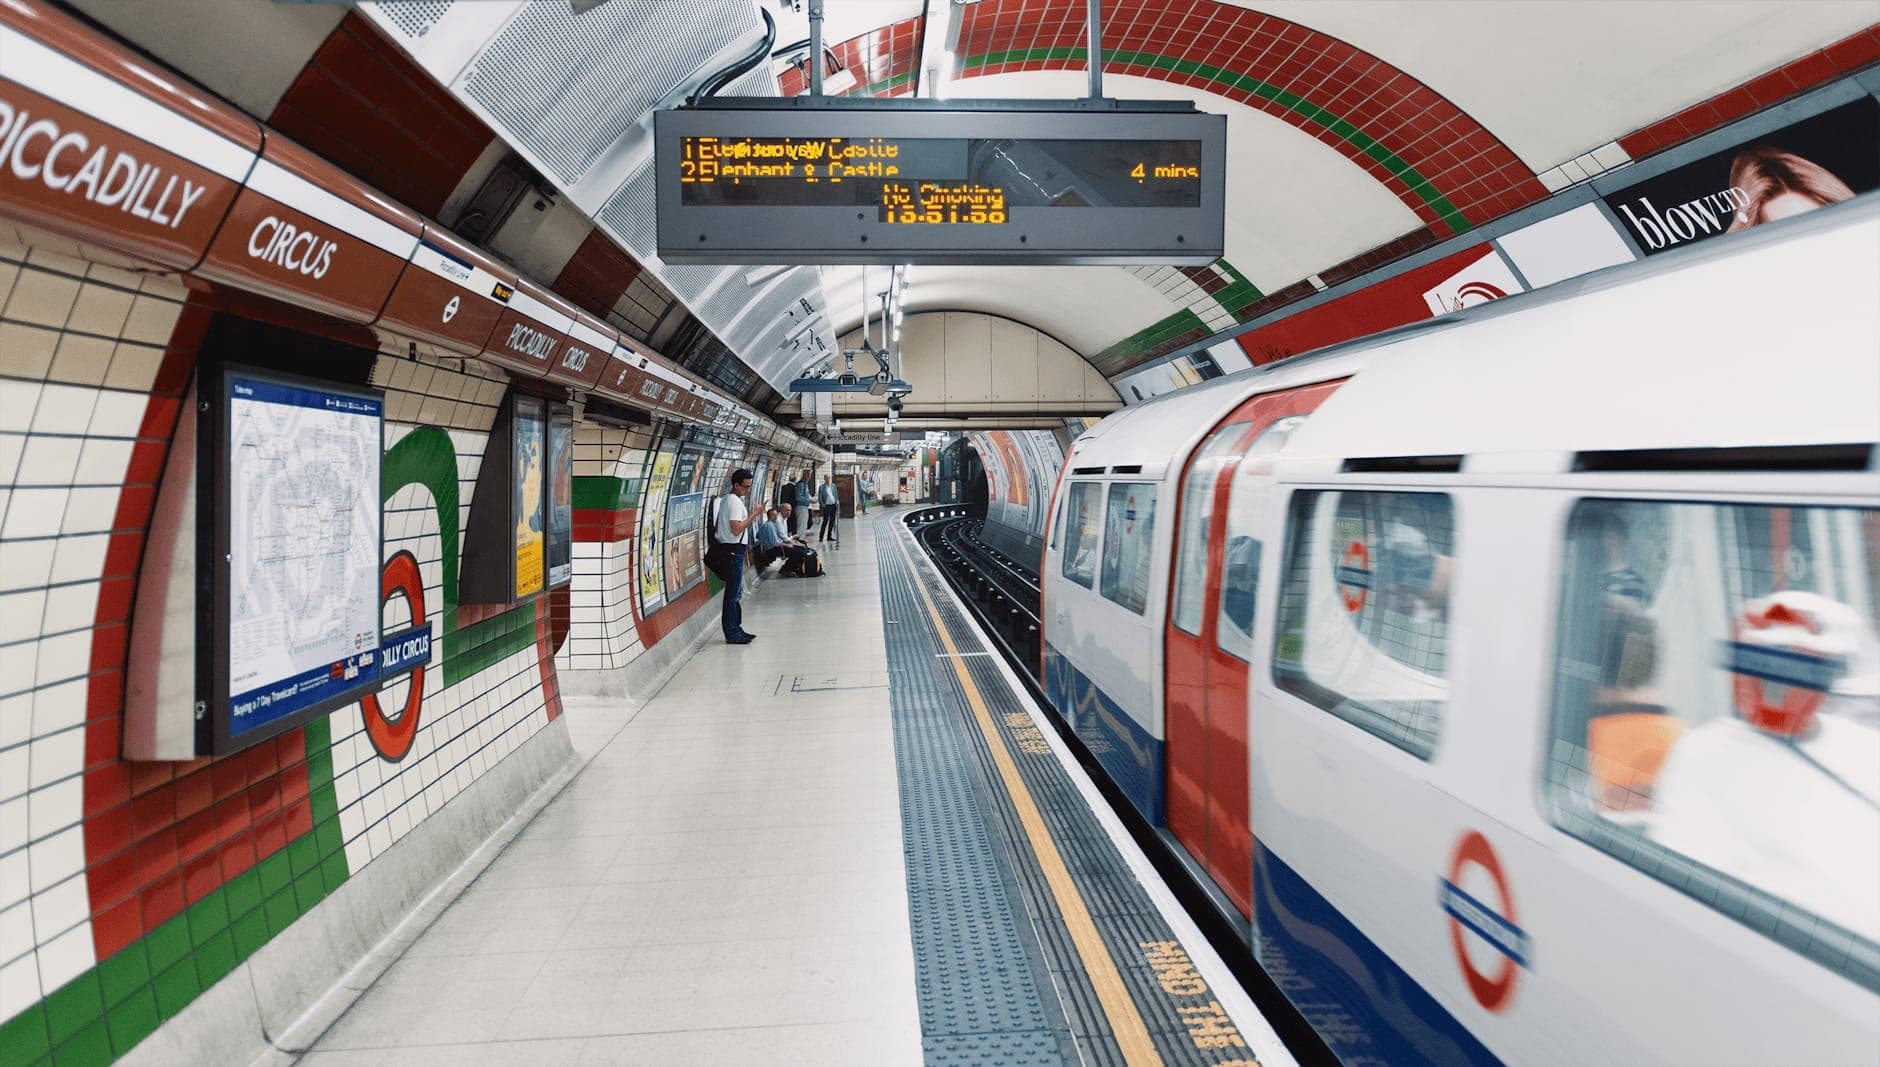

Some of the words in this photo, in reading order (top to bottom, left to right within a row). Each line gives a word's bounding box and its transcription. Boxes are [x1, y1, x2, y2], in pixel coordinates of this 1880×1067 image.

[828, 161, 899, 183] Castle
[1130, 162, 1146, 184] 4
[247, 215, 339, 281] CIRCUS
[402, 634, 429, 661] CIRCUS
[1139, 941, 1208, 996] MIND
